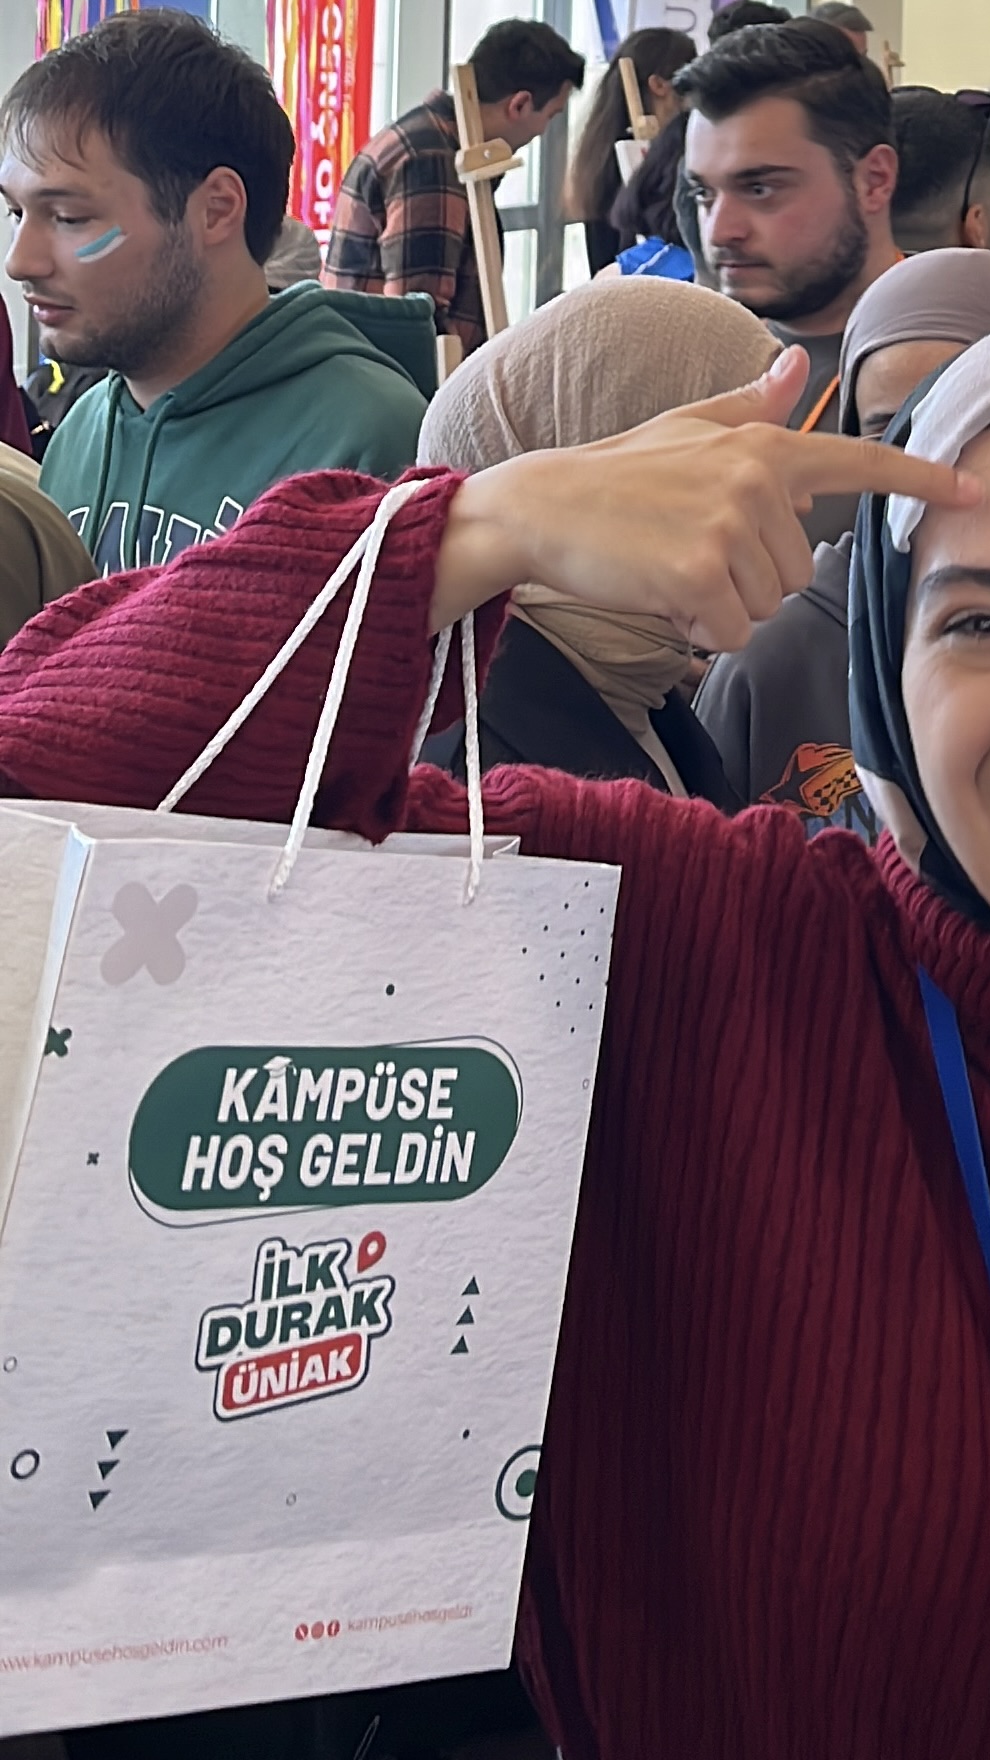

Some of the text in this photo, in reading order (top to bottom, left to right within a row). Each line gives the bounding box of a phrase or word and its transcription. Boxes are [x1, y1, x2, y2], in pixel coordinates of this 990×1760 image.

[181, 1123, 477, 1202] HOŞ GELDİN
[260, 1247, 342, 1302] İLK
[205, 1284, 387, 1358] DURAK
[231, 1344, 354, 1405] ÜNİAK
